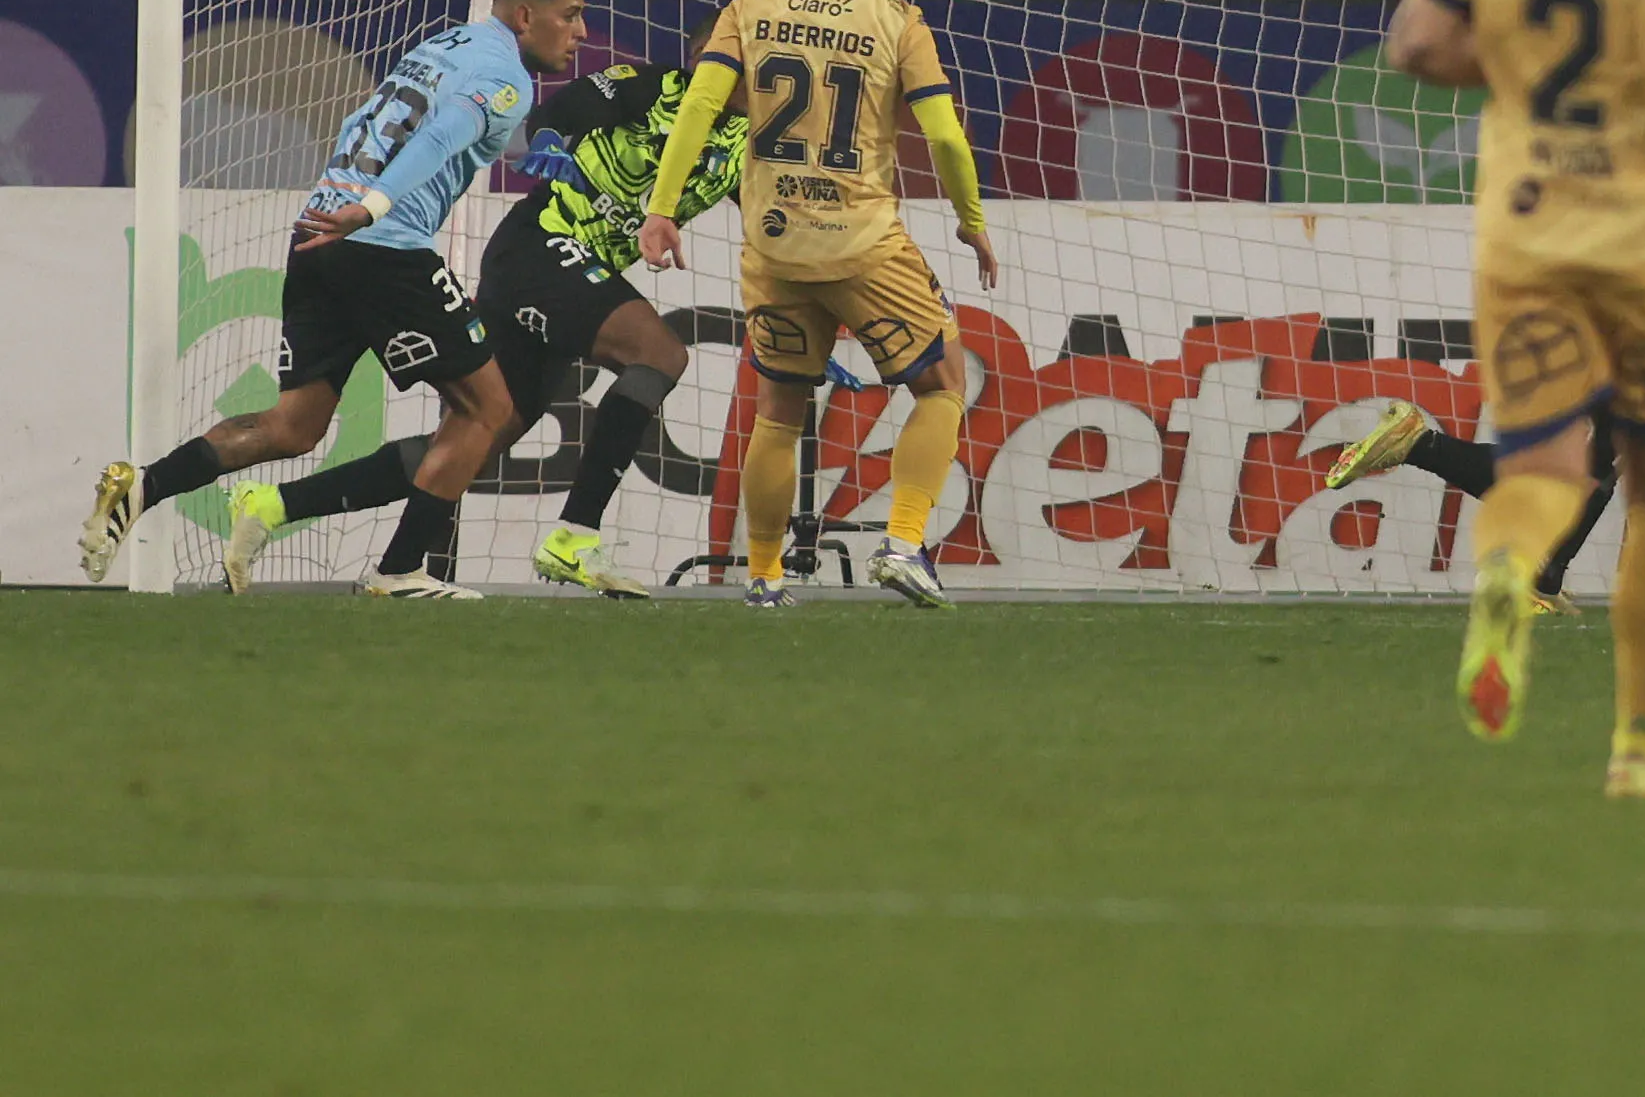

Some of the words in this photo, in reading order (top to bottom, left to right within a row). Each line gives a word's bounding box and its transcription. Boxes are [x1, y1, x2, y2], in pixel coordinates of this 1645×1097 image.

[755, 19, 876, 57] B.BERRIOS
[752, 50, 867, 174] 21
[432, 267, 470, 311] 3
